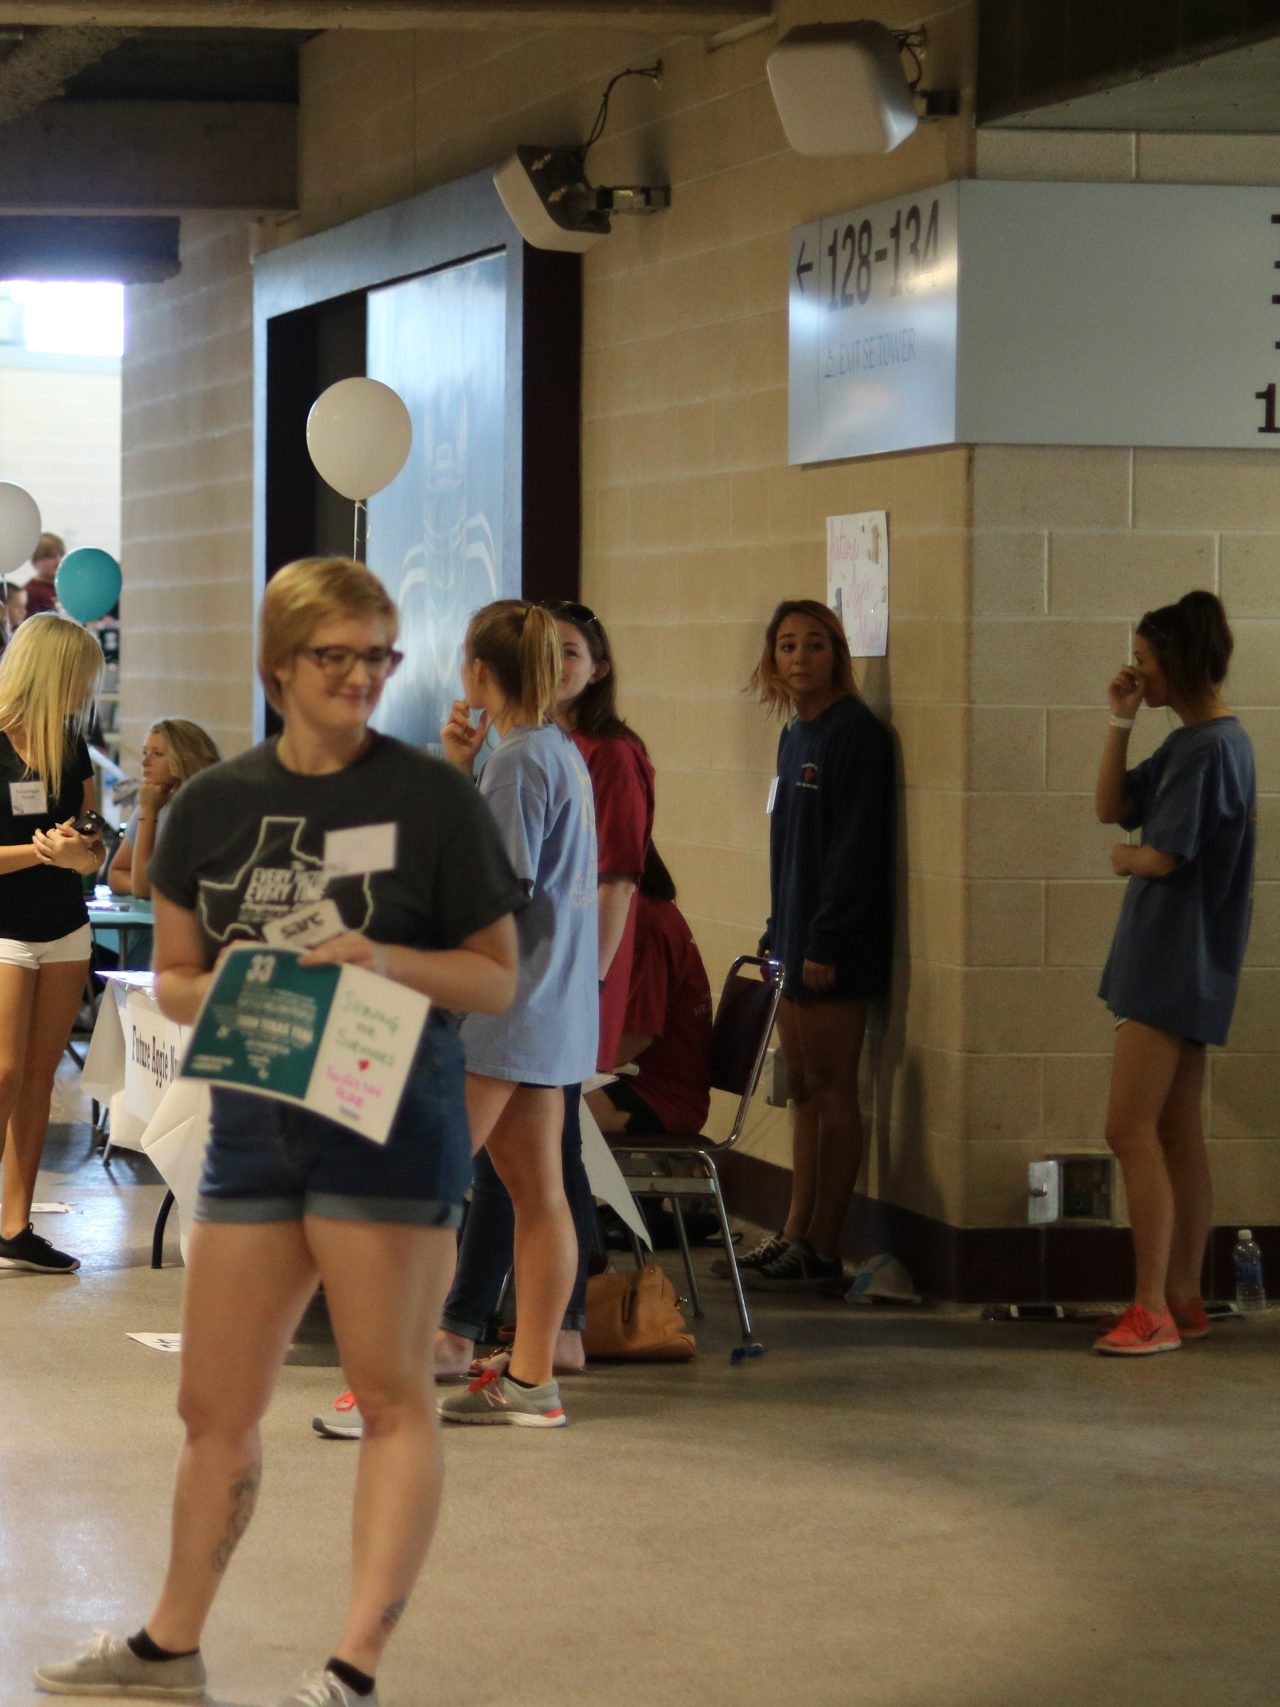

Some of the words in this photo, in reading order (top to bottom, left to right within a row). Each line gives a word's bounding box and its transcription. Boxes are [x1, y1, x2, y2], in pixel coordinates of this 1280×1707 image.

[827, 199, 941, 312] 128-134
[879, 328, 916, 366] TOWER
[131, 1024, 151, 1071] Future
[151, 1035, 169, 1088] Aggie
